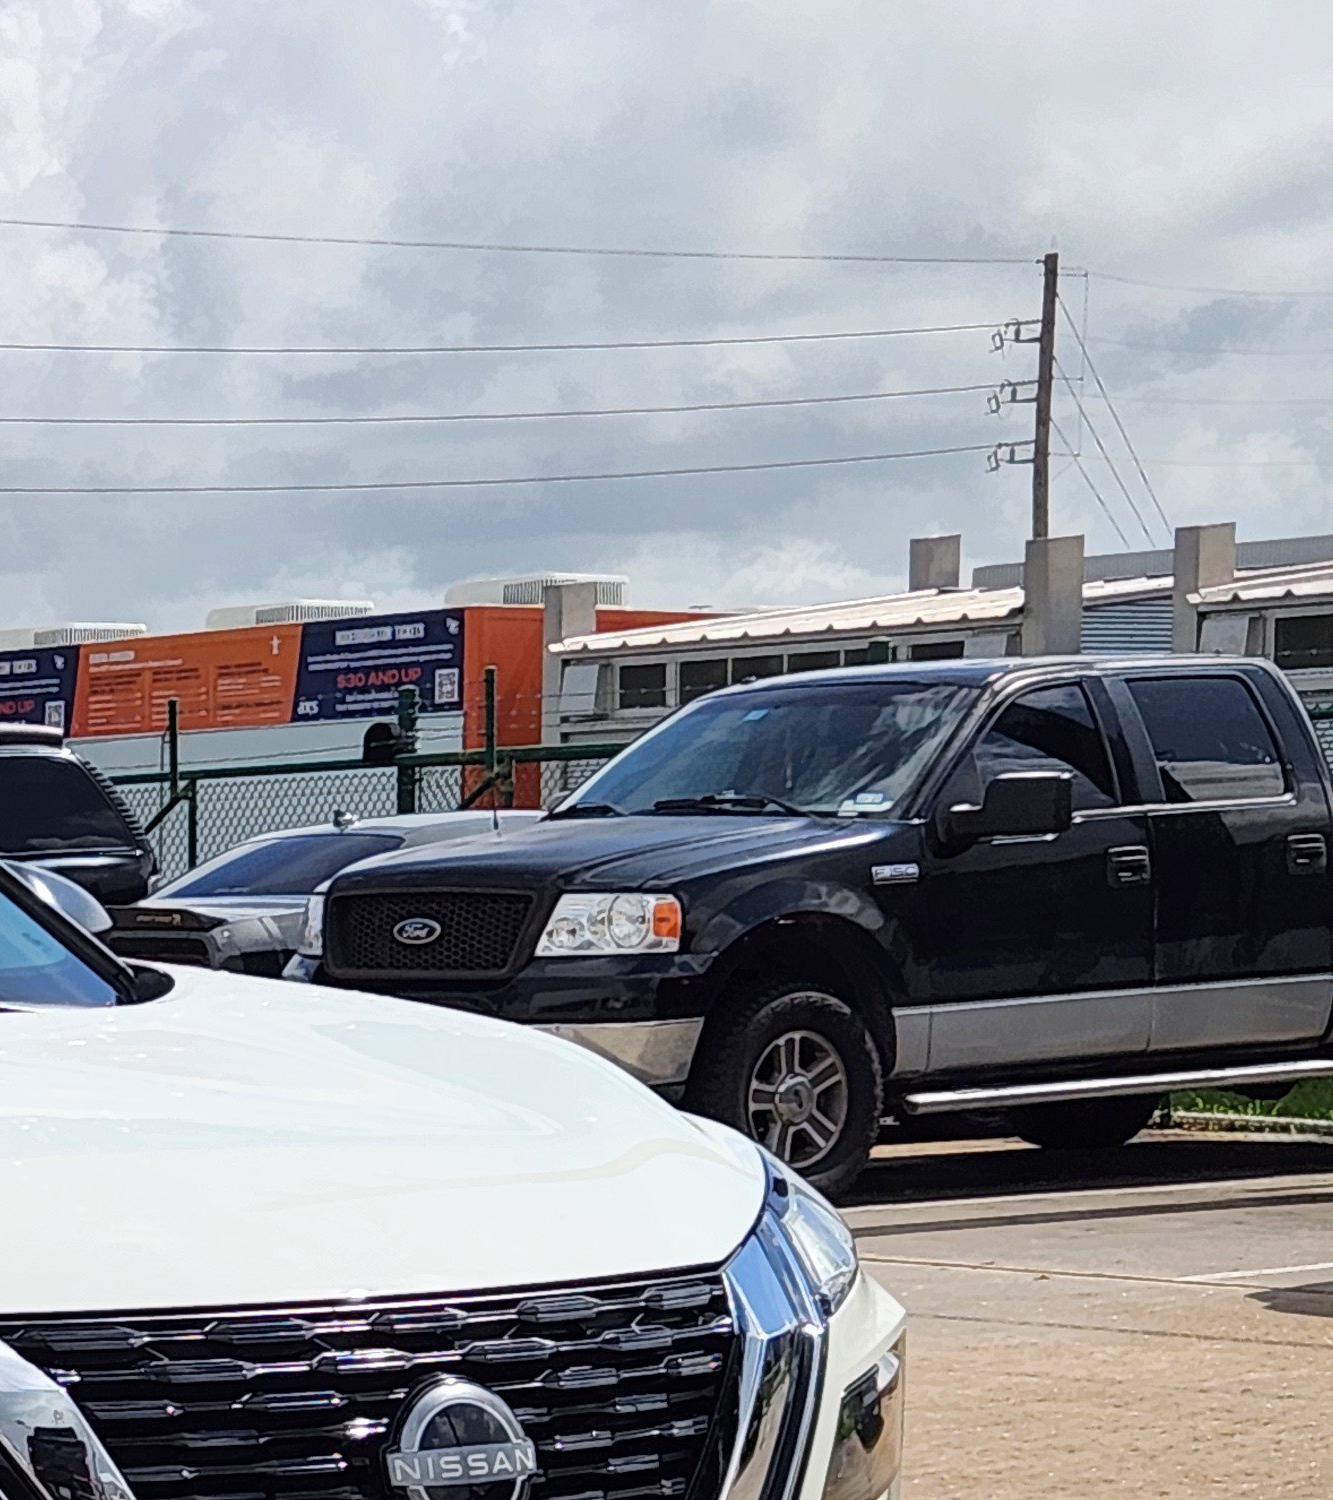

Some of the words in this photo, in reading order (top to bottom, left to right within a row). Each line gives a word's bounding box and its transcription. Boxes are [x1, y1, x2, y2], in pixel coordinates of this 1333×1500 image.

[368, 669, 400, 686] AND
[401, 667, 422, 683] UP
[393, 1447, 535, 1482] NISSAN
